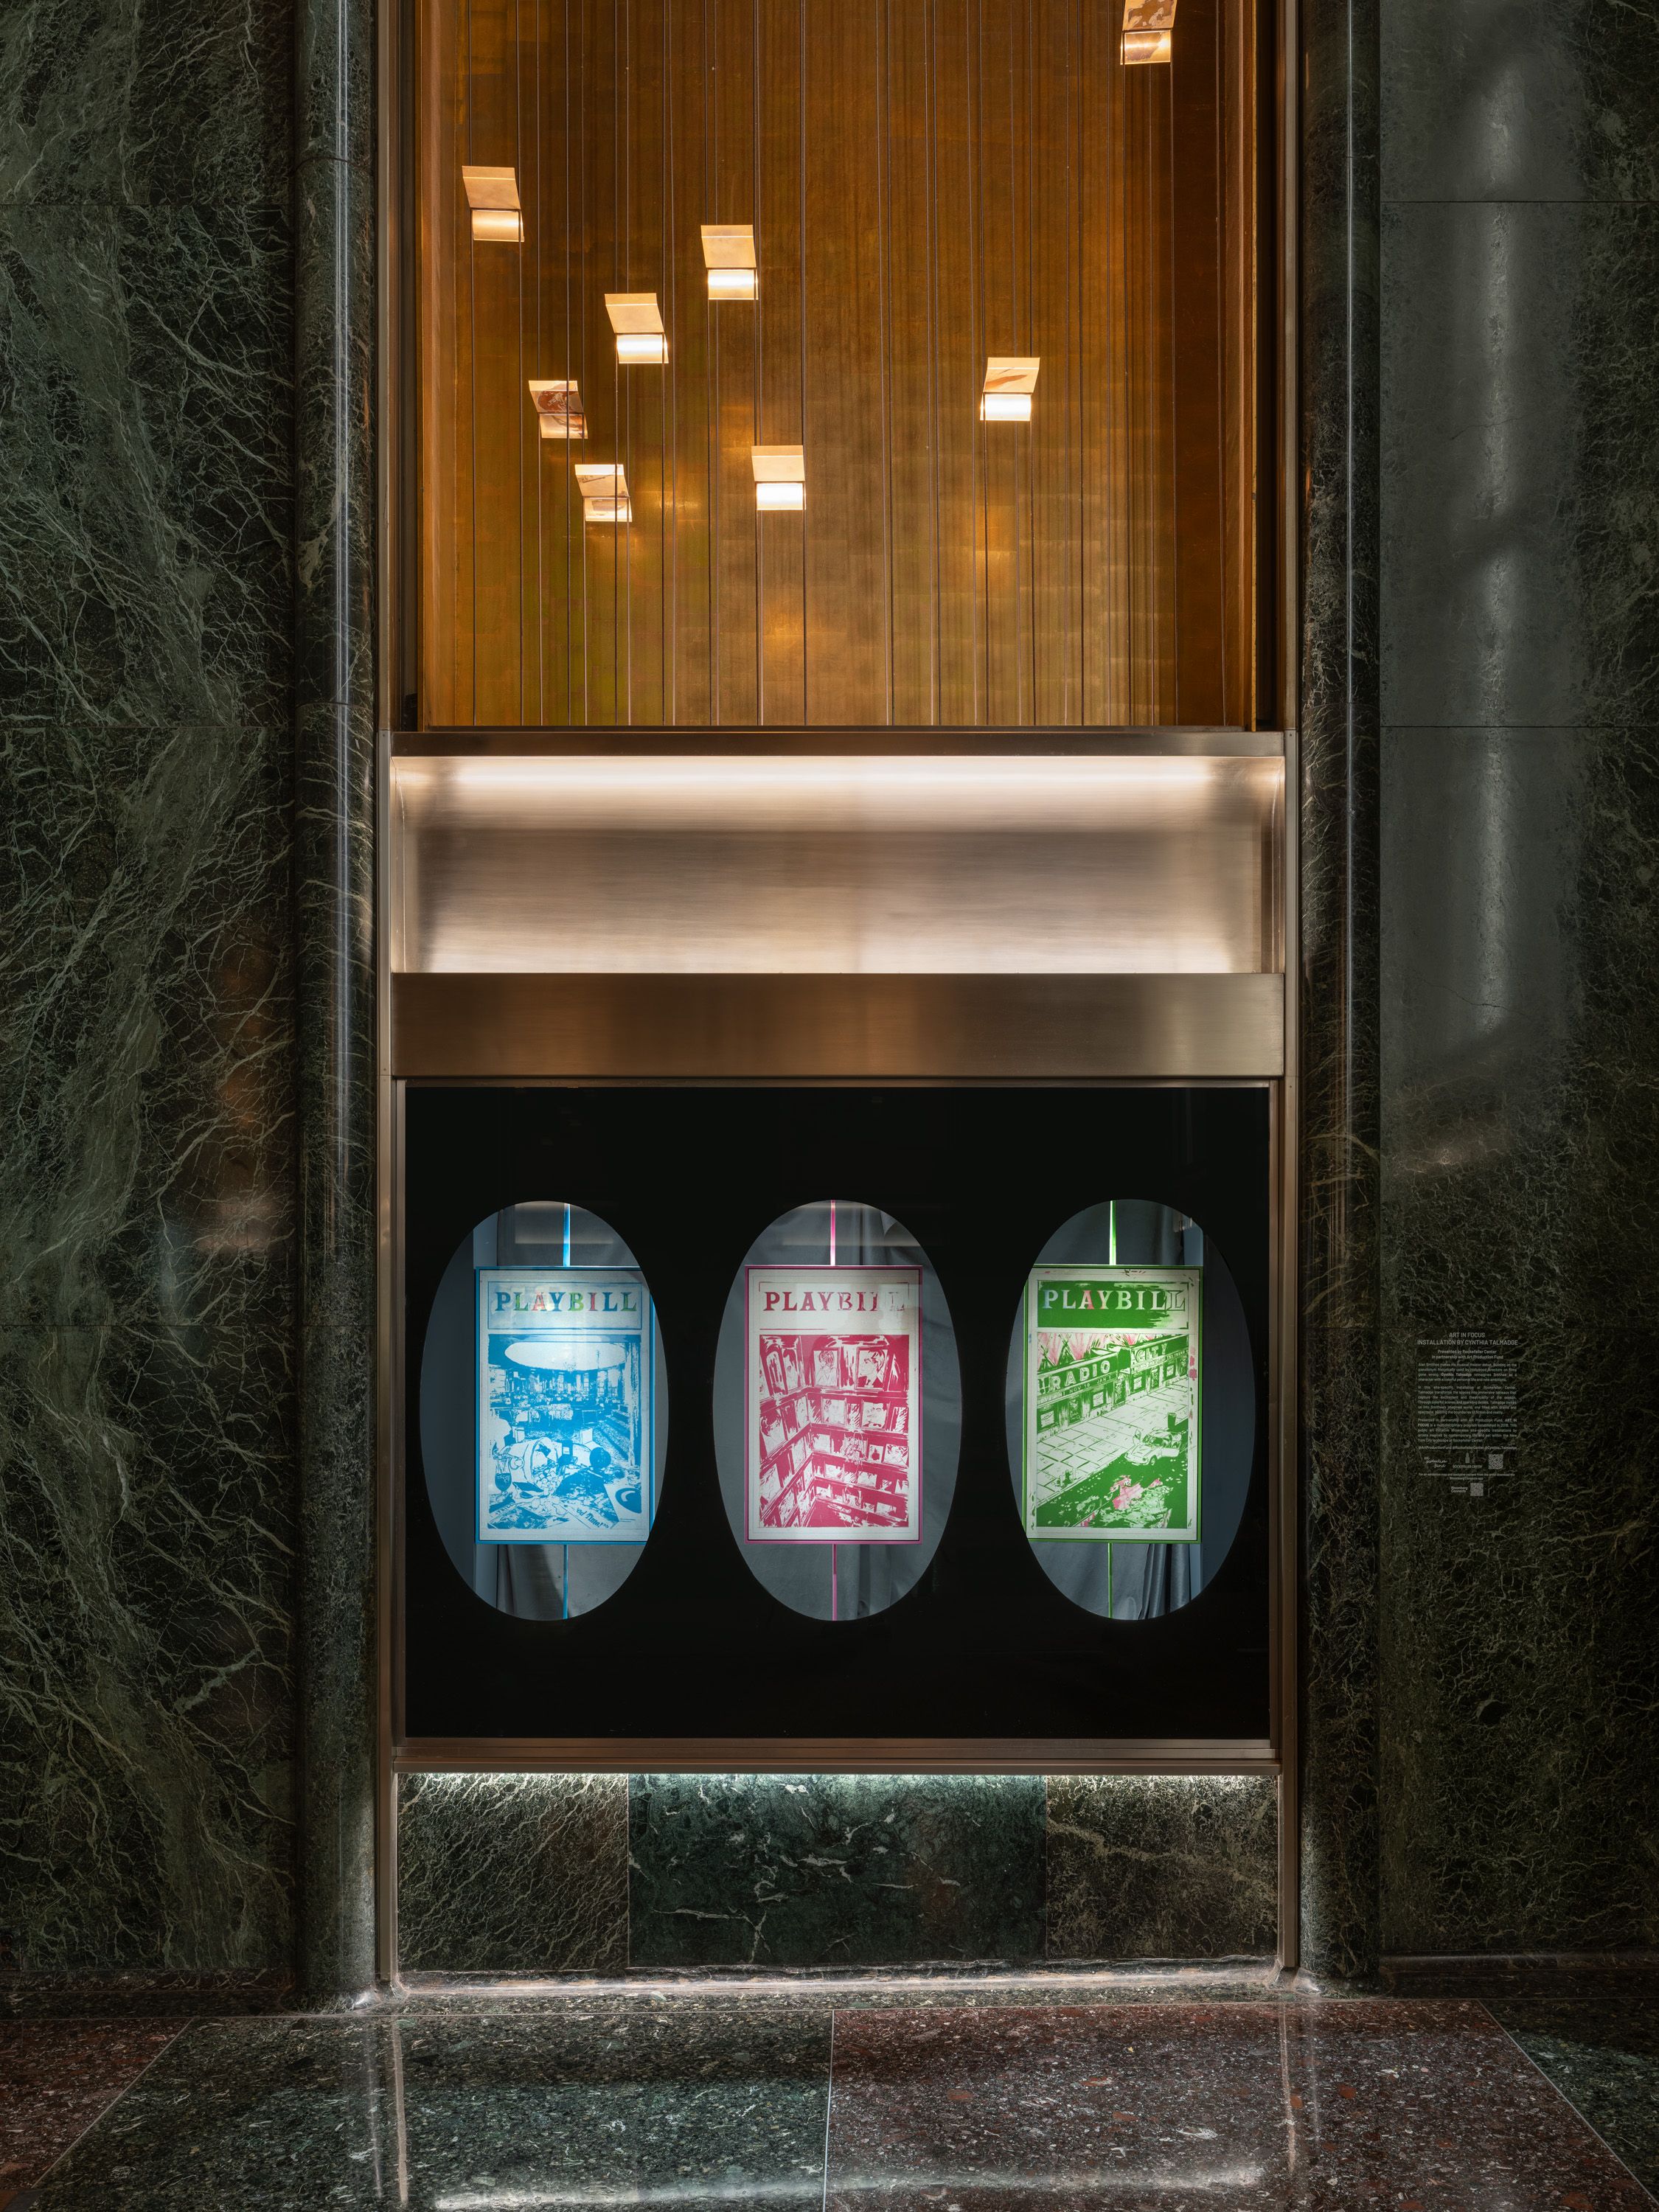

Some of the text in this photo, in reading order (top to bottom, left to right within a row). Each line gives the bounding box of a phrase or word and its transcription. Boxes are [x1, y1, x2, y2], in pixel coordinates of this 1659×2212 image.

[495, 1292, 637, 1312] PLAYBILL
[1042, 1290, 1186, 1311] PLAYBILL
[1048, 1360, 1110, 1393] RADIO
